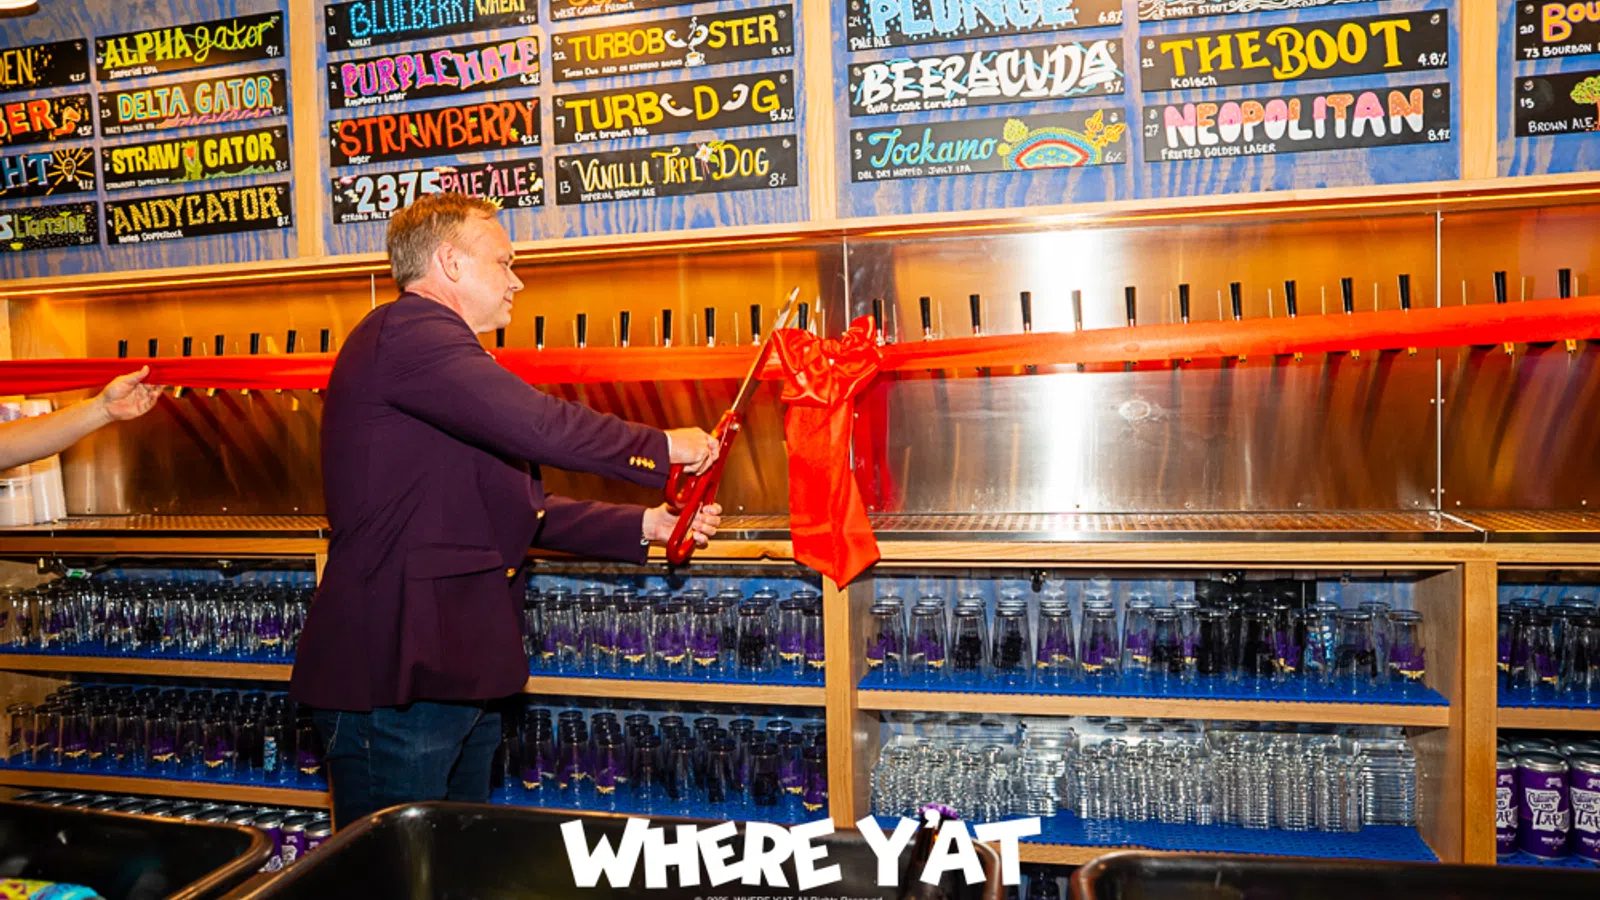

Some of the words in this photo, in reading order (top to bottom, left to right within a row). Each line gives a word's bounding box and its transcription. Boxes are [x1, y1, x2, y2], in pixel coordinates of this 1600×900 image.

[349, 0, 475, 38] BLUEBERRY
[848, 16, 862, 28] 24
[870, 0, 1075, 38] PLUNGE
[1519, 24, 1534, 35] 20
[103, 27, 193, 70] ALPHA
[193, 20, 275, 63] gator
[849, 37, 873, 50] PALE
[874, 35, 891, 47] ALE
[1160, 30, 1272, 77] THE
[1266, 19, 1411, 80] BOOT
[1417, 52, 1447, 67] 4.8%
[1523, 48, 1540, 58] 73
[1542, 43, 1592, 57] BOURBON
[341, 50, 459, 98] PURPLE
[453, 36, 539, 90] HAZE
[861, 40, 1118, 106] BEERACUDA
[117, 86, 190, 123] DELTA
[194, 76, 273, 114] GATOR
[1163, 88, 1425, 148] NEOPOLITAN
[1520, 98, 1535, 109] 15
[338, 100, 539, 157] STRAWBERRY
[1144, 124, 1159, 137] 27
[1528, 120, 1568, 133] BROWN
[1572, 116, 1595, 130] ALE
[111, 142, 180, 174] STRAW
[204, 132, 276, 168] GATOR
[571, 159, 655, 192] VANILLA
[712, 143, 770, 181] DOG
[1104, 151, 1122, 163] 6%
[1161, 148, 1201, 160] FRUITED
[1204, 145, 1241, 158] GOLDEN
[1243, 143, 1276, 154] LAGER
[355, 171, 443, 214] 2375
[440, 170, 485, 199] PALE
[489, 166, 529, 198] ALE
[559, 180, 571, 195] 13
[114, 186, 283, 236] ANDYGATOR
